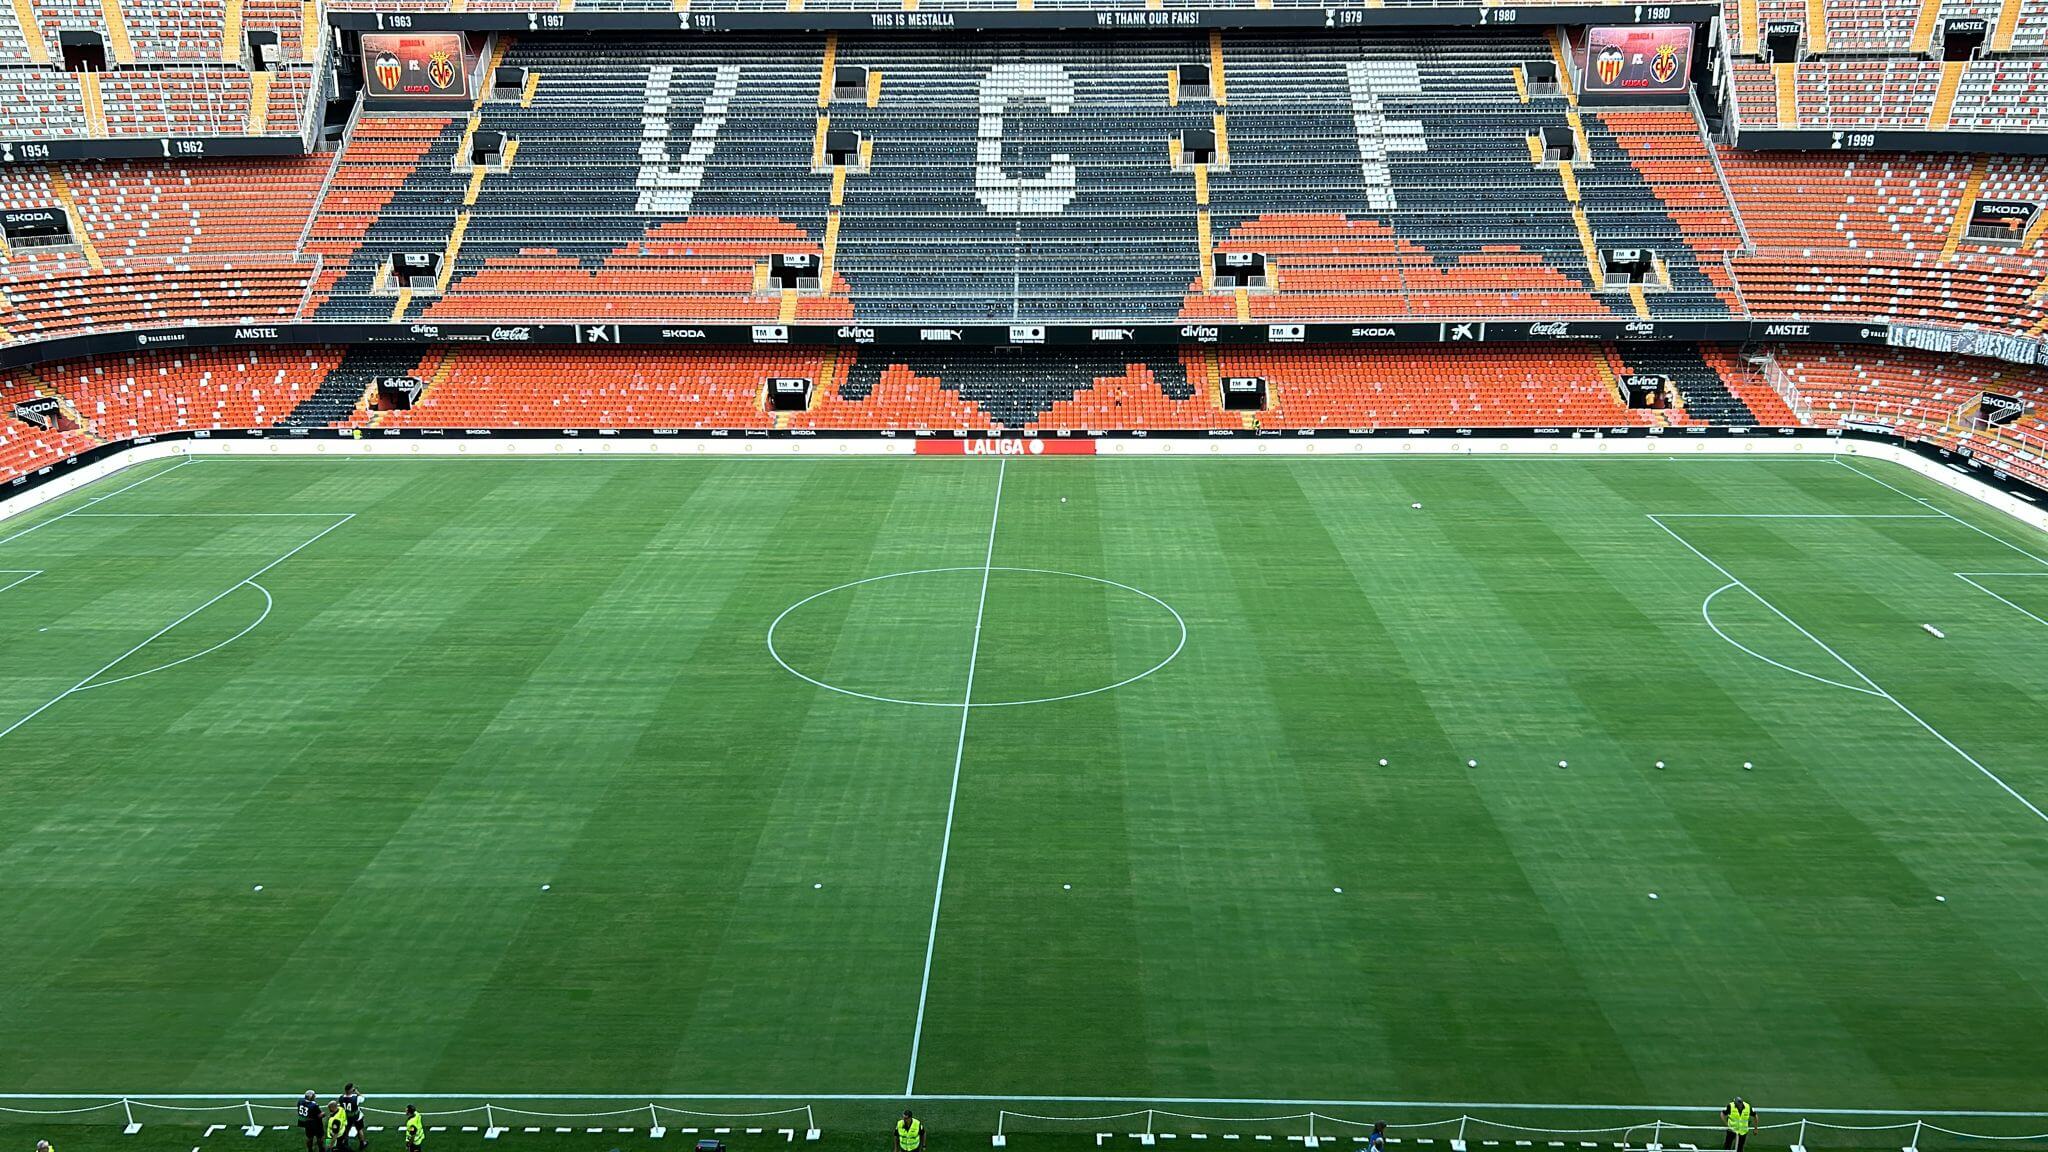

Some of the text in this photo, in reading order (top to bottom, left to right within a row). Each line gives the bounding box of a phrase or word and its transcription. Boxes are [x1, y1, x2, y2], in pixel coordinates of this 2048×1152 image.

[872, 14, 955, 26] THIS IS MESTALLA
[1097, 12, 1200, 25] WE THANK OUR FANS!
[1340, 11, 1362, 24] 1979
[1493, 9, 1516, 22] 1980
[1647, 8, 1671, 20] 1980
[389, 16, 412, 28] 1963
[542, 15, 564, 27] 1967
[695, 15, 716, 27] 1971
[1949, 21, 1984, 30] AMSTEL
[1768, 25, 1800, 33] AMSTEL
[1847, 134, 1874, 147] 1999
[20, 144, 50, 158] 1954
[177, 141, 204, 153] 1962
[1982, 205, 2030, 215] SKODA
[6, 212, 54, 222] SKODA
[837, 326, 874, 337] divina
[1181, 326, 1218, 337] divina
[1352, 328, 1396, 337] SKODA
[1625, 322, 1654, 331] divina
[1765, 325, 1810, 336] AMSTEL
[235, 328, 278, 339] AMSTEL
[662, 329, 706, 338] SKODA
[920, 329, 952, 341] PUMA
[1887, 326, 1905, 347] LA
[1905, 328, 1952, 352] CURVA
[384, 378, 414, 387] divina
[1627, 376, 1659, 385] divina
[17, 401, 59, 416] SKODA
[1982, 396, 2022, 412] SKODA
[963, 438, 1025, 455] LALIGA
[298, 1105, 309, 1117] 53
